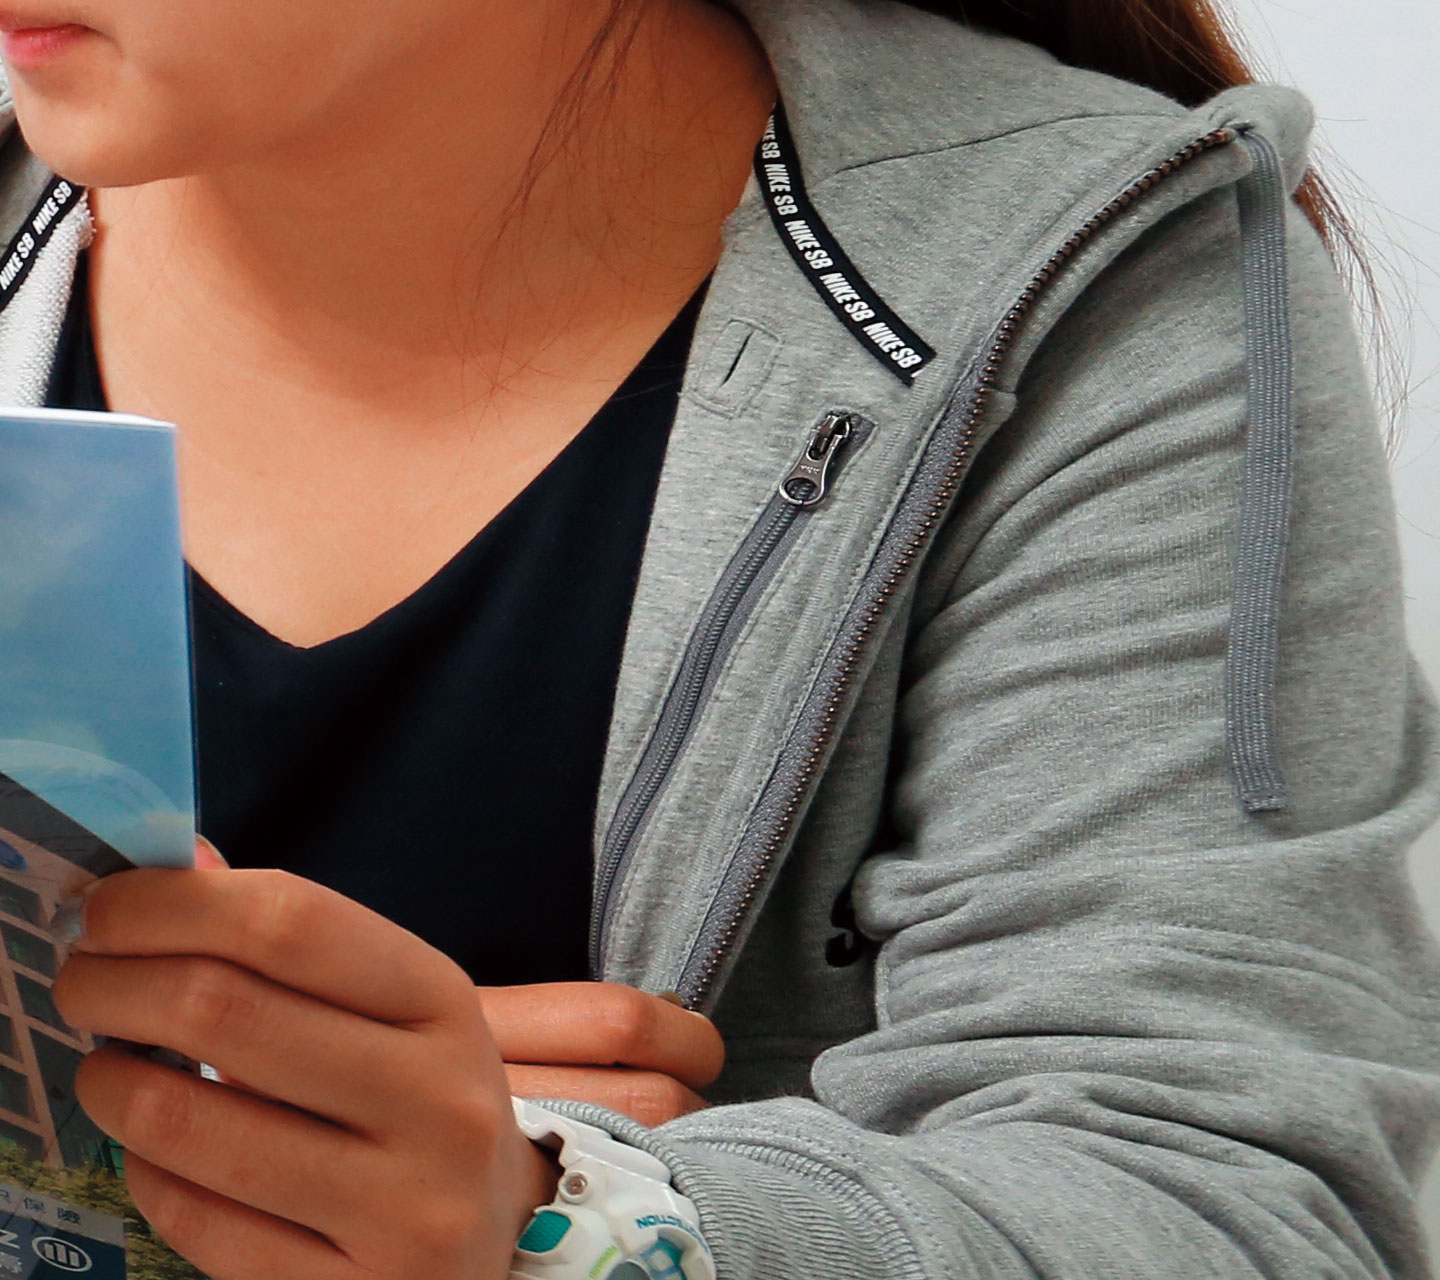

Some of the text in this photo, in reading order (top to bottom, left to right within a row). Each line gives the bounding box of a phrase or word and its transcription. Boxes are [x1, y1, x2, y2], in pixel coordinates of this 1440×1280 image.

[764, 163, 791, 193] NIKE
[17, 232, 35, 259] SB
[32, 197, 60, 235] NIKE
[53, 181, 72, 205] SB
[774, 194, 799, 216] SB
[784, 219, 820, 251] NIKE
[804, 250, 834, 270] SB
[819, 272, 853, 304] NIKE
[845, 301, 875, 323] SB
[862, 322, 900, 354] NIKE
[890, 346, 923, 369] SB
